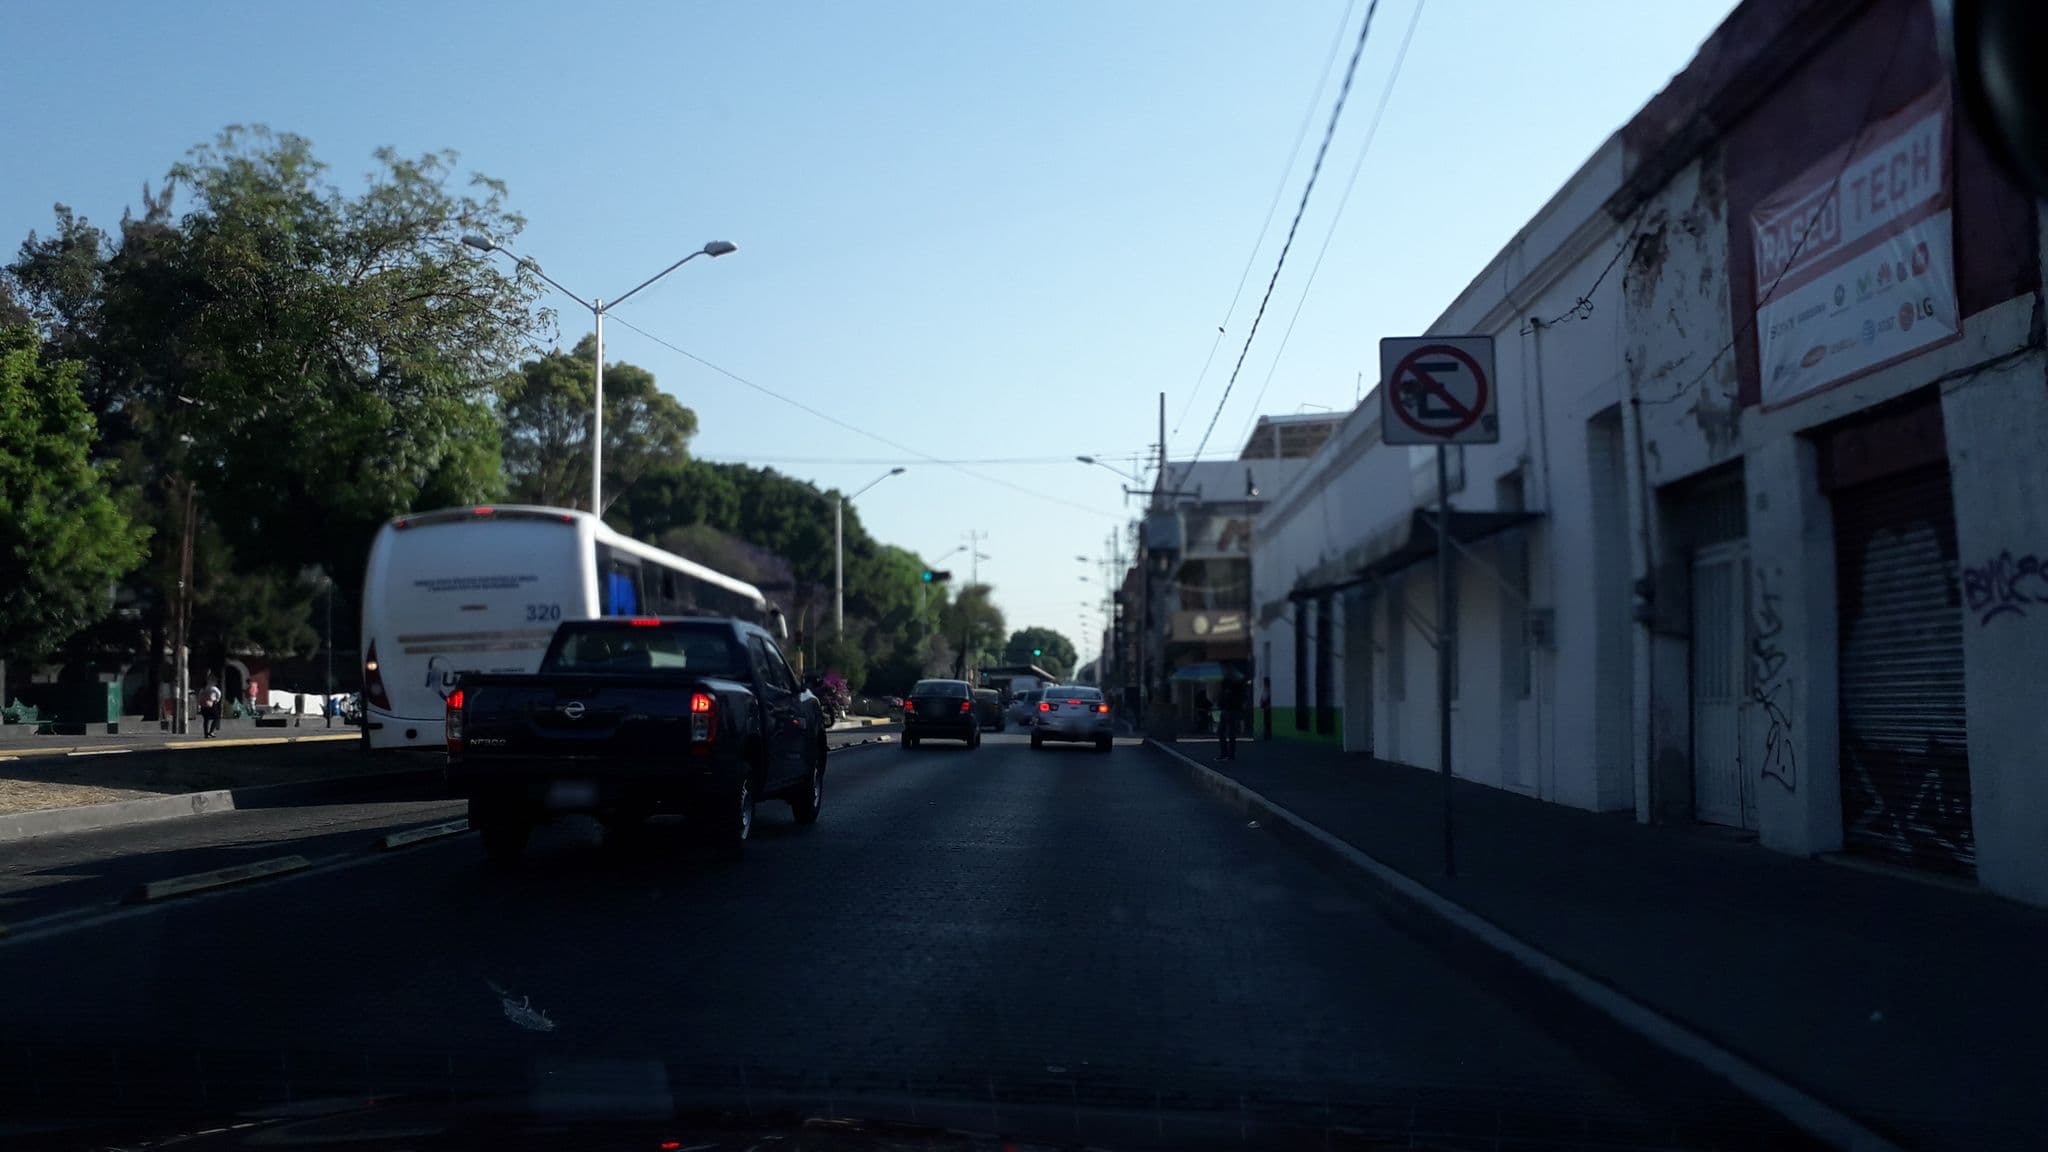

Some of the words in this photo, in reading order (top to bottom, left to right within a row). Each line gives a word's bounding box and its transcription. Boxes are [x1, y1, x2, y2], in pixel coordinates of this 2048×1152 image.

[1851, 135, 1931, 222] TECH
[1916, 297, 1934, 321] LG
[526, 604, 561, 621] 320
